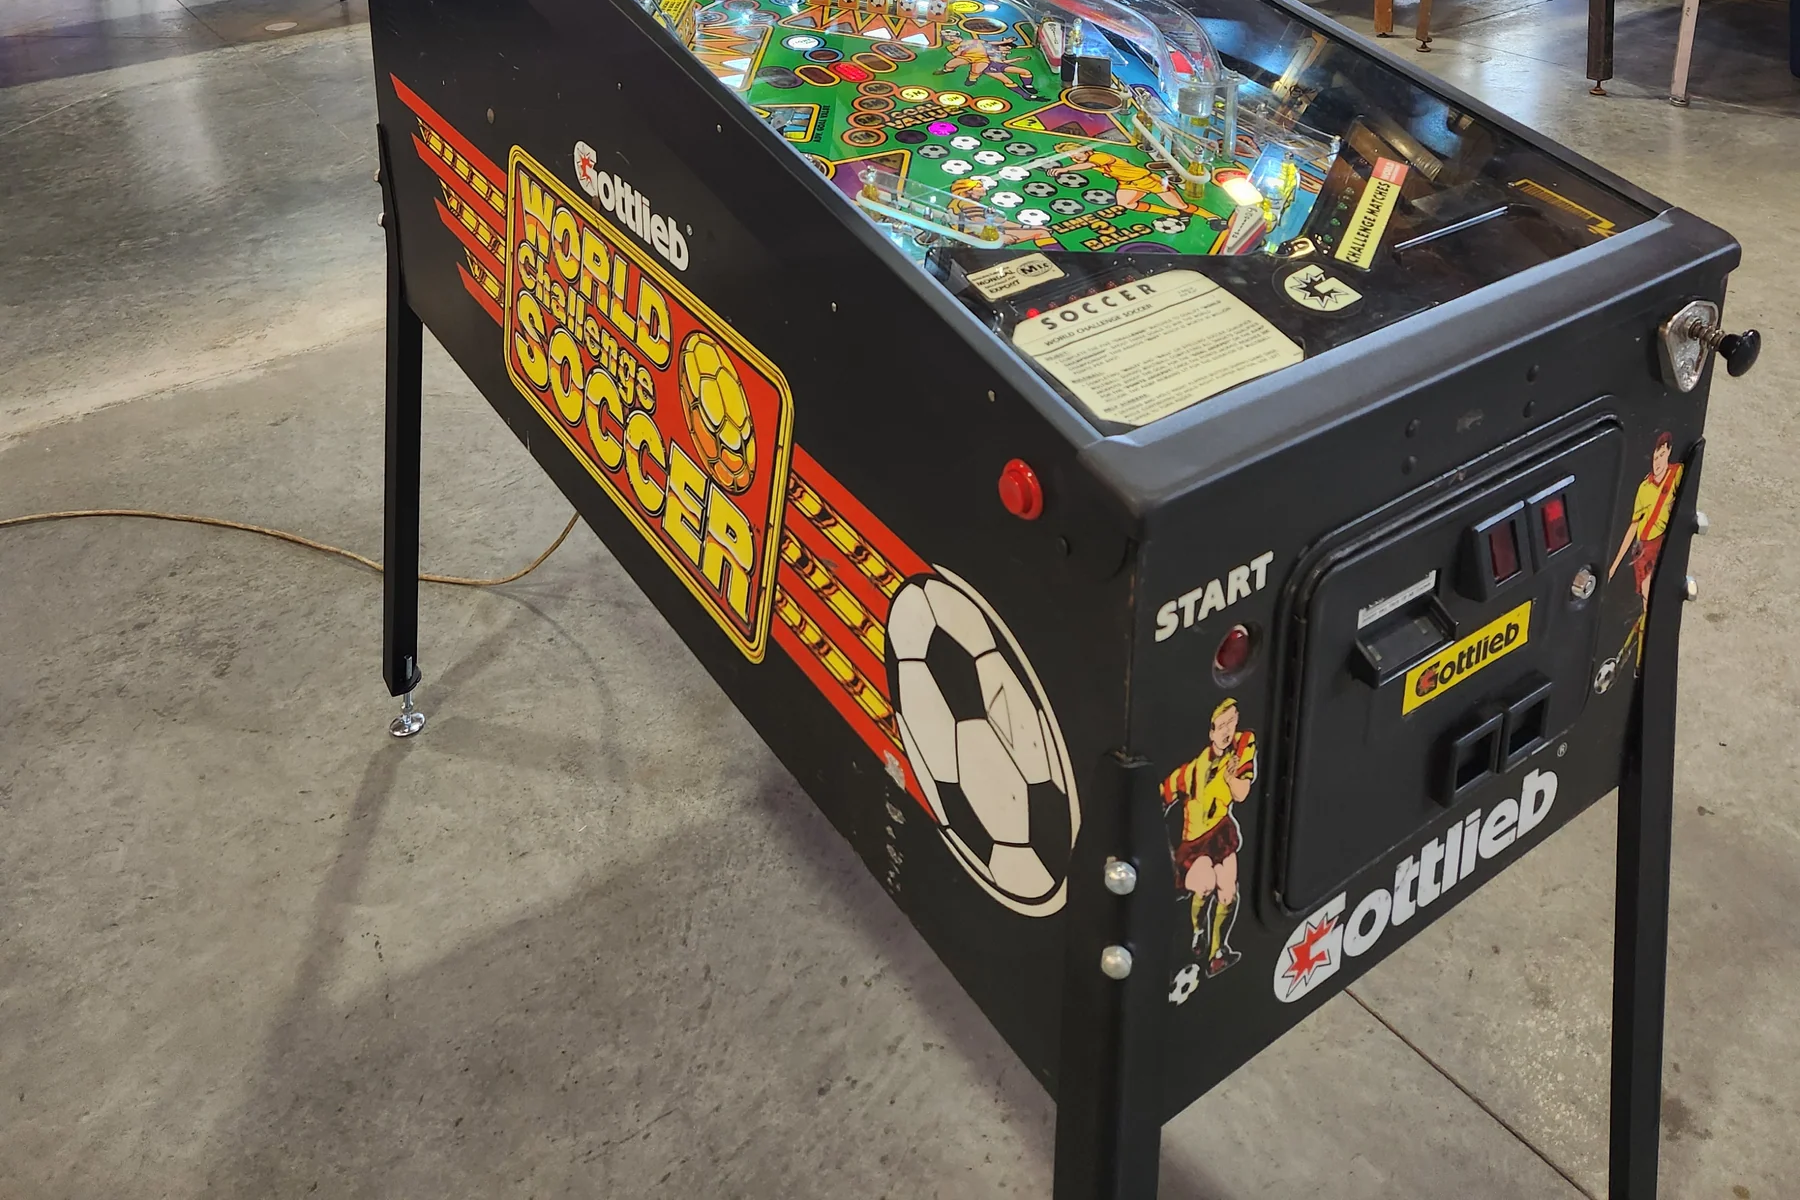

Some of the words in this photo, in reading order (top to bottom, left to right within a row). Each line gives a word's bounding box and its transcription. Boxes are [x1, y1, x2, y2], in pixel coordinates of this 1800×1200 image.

[890, 102, 942, 120] GOAL
[905, 89, 925, 99] 5M
[1026, 118, 1037, 127] ?
[573, 140, 691, 272] Gottlieb
[1053, 213, 1102, 234] LINE
[1096, 205, 1127, 219] UP
[1345, 216, 1378, 264] CHALLENGE
[1370, 181, 1392, 218] MATCHES
[1083, 224, 1153, 251] BALLS
[519, 169, 672, 372] WORLD
[988, 278, 1021, 294] EXPORT
[518, 240, 656, 414] Challenge
[1040, 283, 1158, 331] SOCCER
[1044, 331, 1076, 347] WORLD
[1076, 316, 1121, 334] CHALLENGE
[1122, 303, 1154, 318] SOCCER
[514, 288, 757, 626] SOCCER
[1154, 550, 1274, 643] START
[1415, 621, 1520, 698] Gottlieb
[1273, 768, 1559, 1003] Gottlieb
